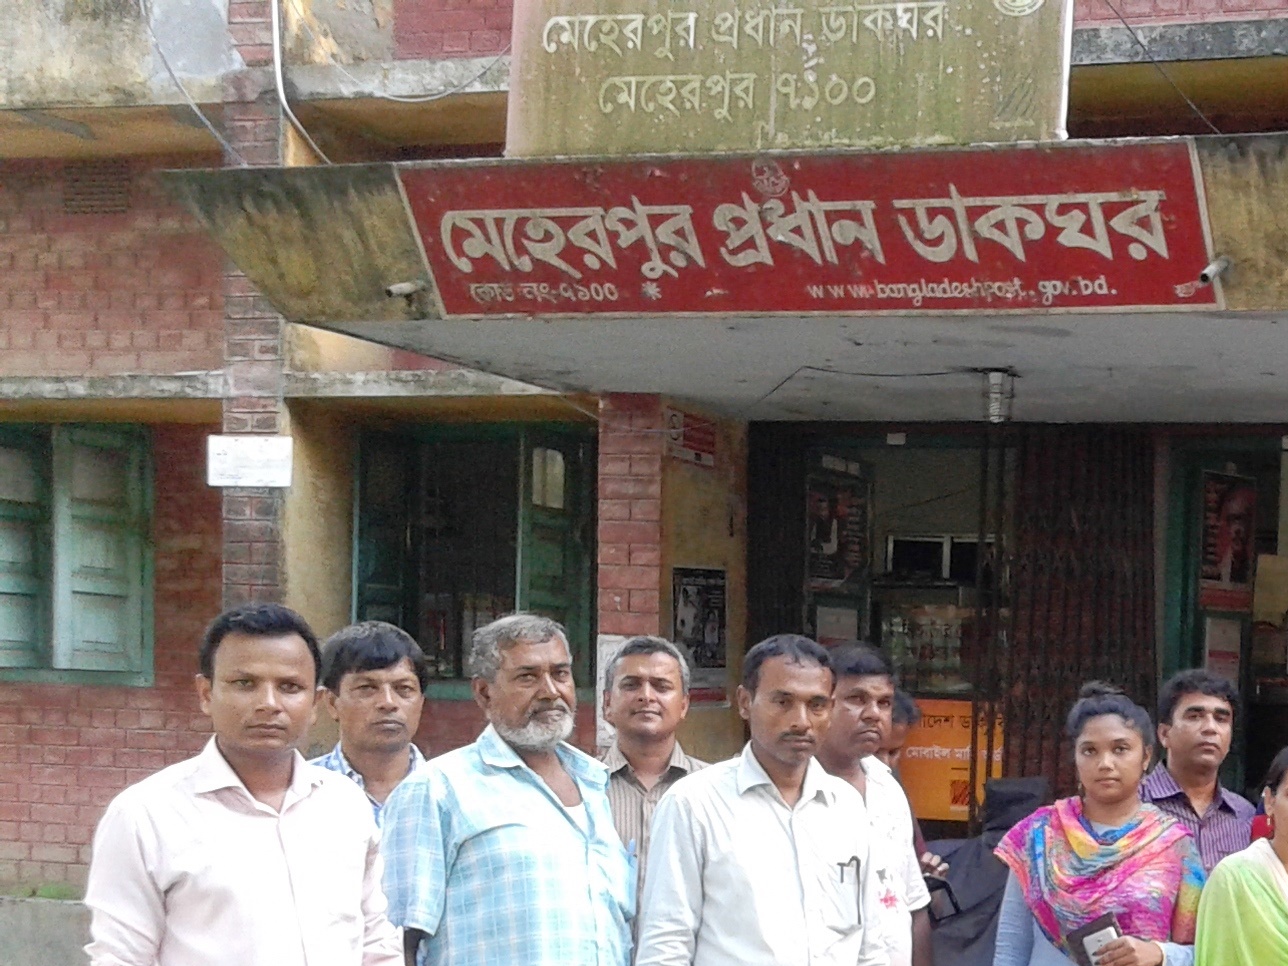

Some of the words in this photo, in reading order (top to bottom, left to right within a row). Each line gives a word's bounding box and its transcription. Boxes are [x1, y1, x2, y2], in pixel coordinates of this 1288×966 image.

[542, 11, 697, 59] মেহেরপুর
[711, 4, 802, 51] প্রধান
[820, 0, 947, 45] ডাকঘর
[598, 70, 756, 121] মেহেরপুর
[775, 72, 877, 112] ৭১০০
[440, 195, 706, 281] মেহেরপুর
[713, 189, 885, 267] প্রধান
[892, 182, 1170, 264] ডাকঘর
